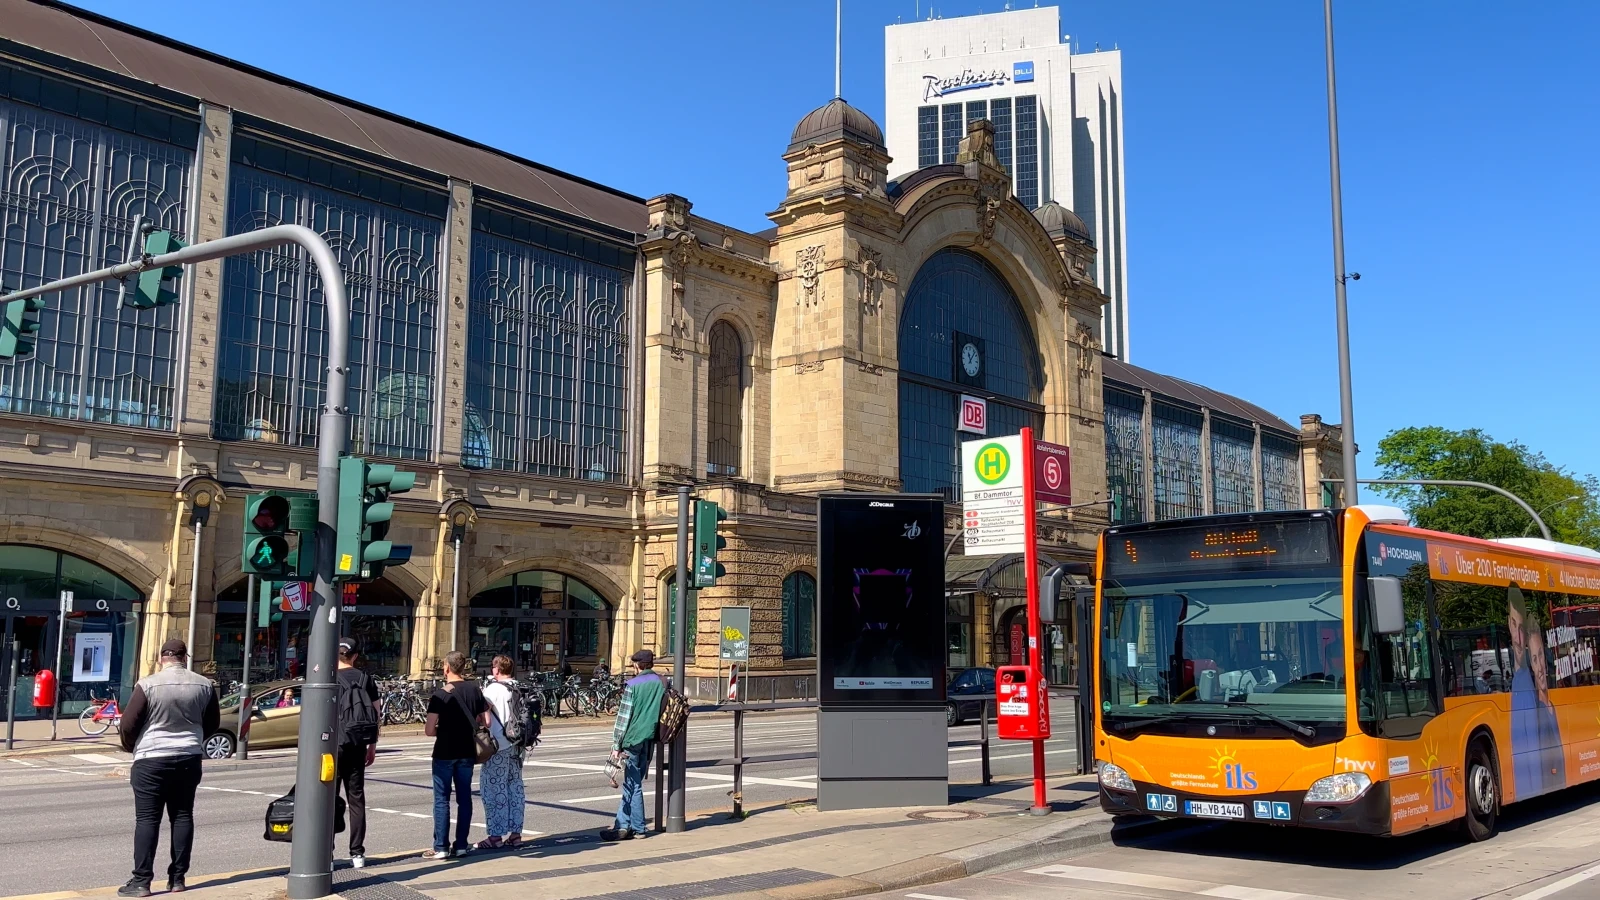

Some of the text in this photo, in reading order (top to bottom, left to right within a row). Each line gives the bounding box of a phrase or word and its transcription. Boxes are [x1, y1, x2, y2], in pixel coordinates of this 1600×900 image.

[922, 65, 1033, 102] Radisson BLU
[965, 404, 982, 424] DB
[1036, 444, 1067, 456] Abfahrtsbereich
[984, 452, 1001, 475] H
[1048, 462, 1058, 484] 5
[1386, 547, 1422, 562] HOCHBAHN
[1455, 551, 1540, 586] Über 200 Fernlehrgänge
[1565, 571, 1585, 588] Wochen
[1546, 625, 1577, 648] Mit Bildung
[1554, 642, 1594, 680] zum Erfolg
[1170, 772, 1206, 780] Deutschlands
[1189, 780, 1218, 788] Fernschule
[1225, 763, 1258, 790] ils
[1392, 792, 1420, 806] Deutschlands
[1432, 767, 1454, 812] ils
[1191, 803, 1243, 816] HH YB 1440
[1393, 804, 1428, 822] größte Fernschule
